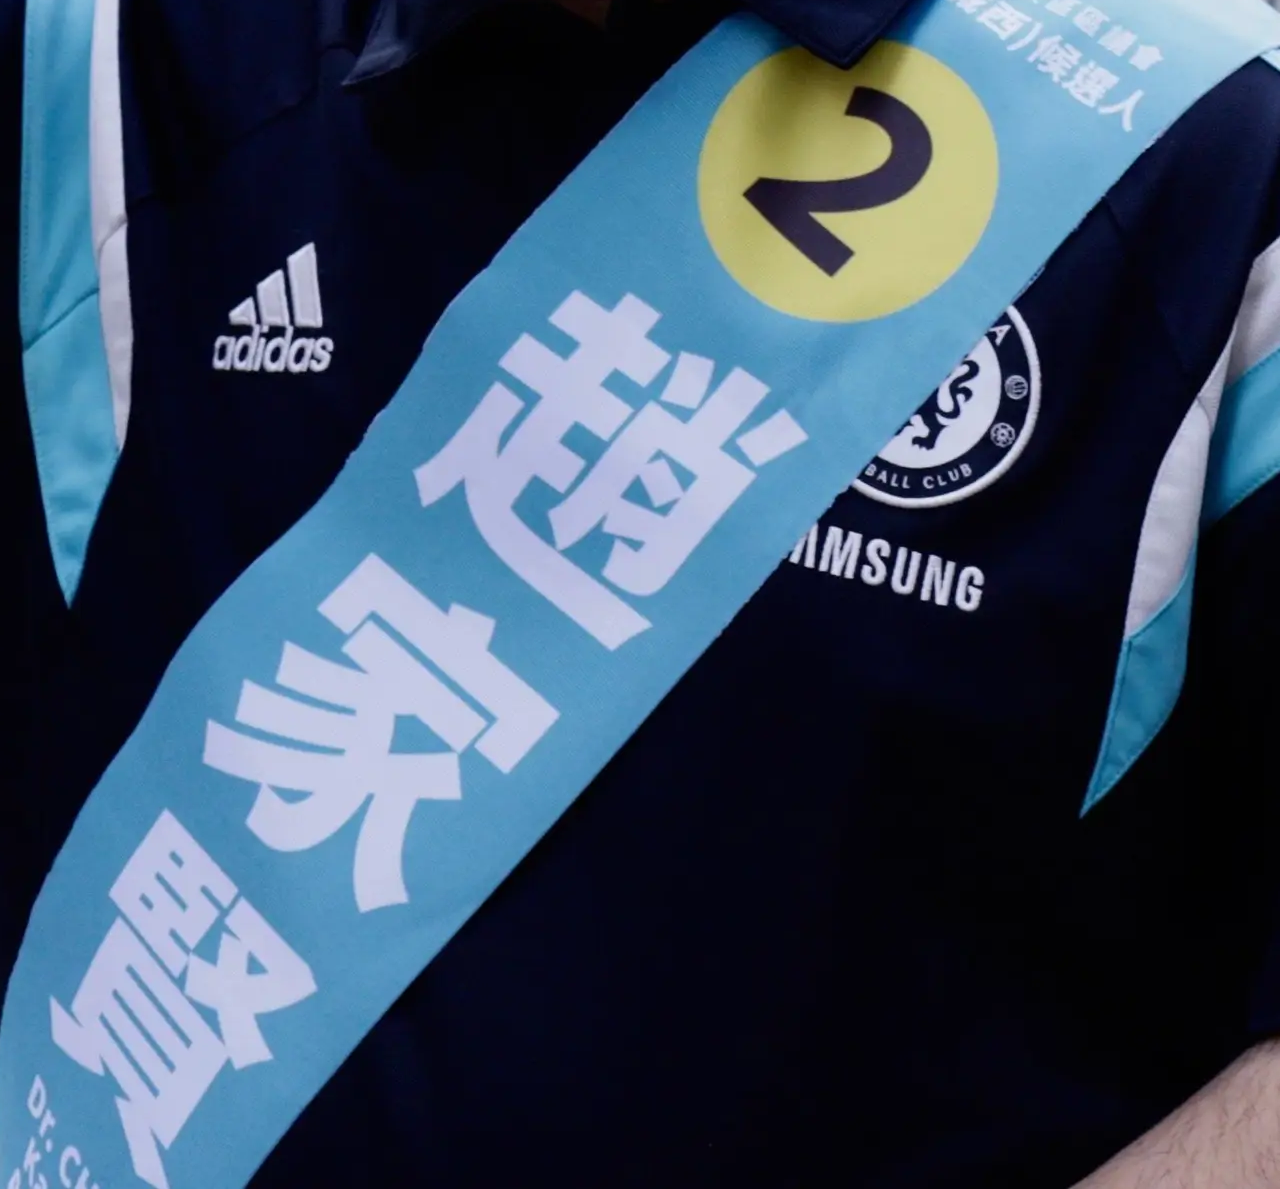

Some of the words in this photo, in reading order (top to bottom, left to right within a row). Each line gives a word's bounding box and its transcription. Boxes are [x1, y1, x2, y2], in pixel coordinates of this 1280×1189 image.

[742, 86, 933, 277] 2
[213, 324, 334, 373] adidas
[922, 462, 972, 490] CLUB
[49, 289, 810, 1189] 趙家賢
[27, 1074, 56, 1153] Dr.
